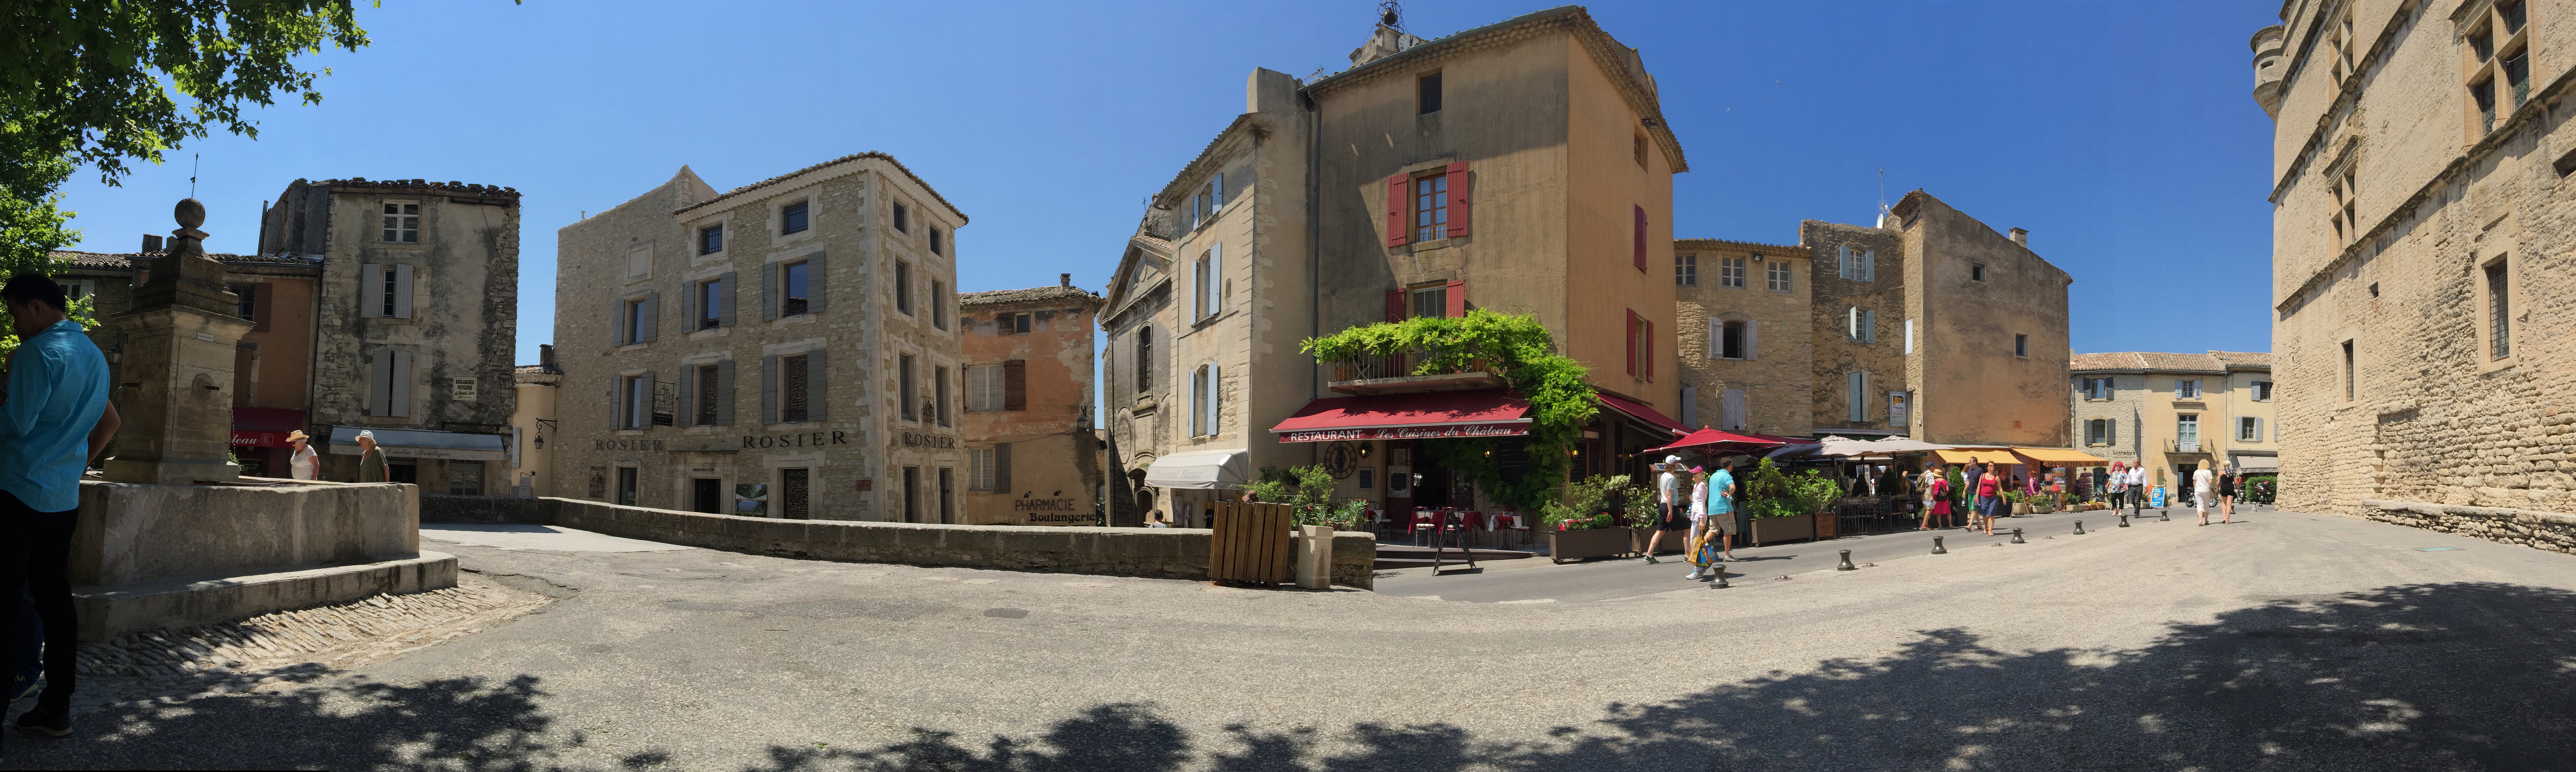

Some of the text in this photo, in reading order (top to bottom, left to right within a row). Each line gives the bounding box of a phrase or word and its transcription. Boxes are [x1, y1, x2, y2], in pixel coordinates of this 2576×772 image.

[1291, 430, 1362, 441] RESTAURANT
[1376, 425, 1512, 439] Les Cuisines du Château
[596, 439, 663, 451] ROSIER
[742, 431, 848, 448] ROSIER
[905, 431, 955, 449] ROSIER
[415, 449, 450, 458] Boutique
[1154, 469, 1203, 479] Provencal Bazaar
[1015, 499, 1075, 511] PHARMACIE
[1029, 513, 1096, 523] Boulangerie
